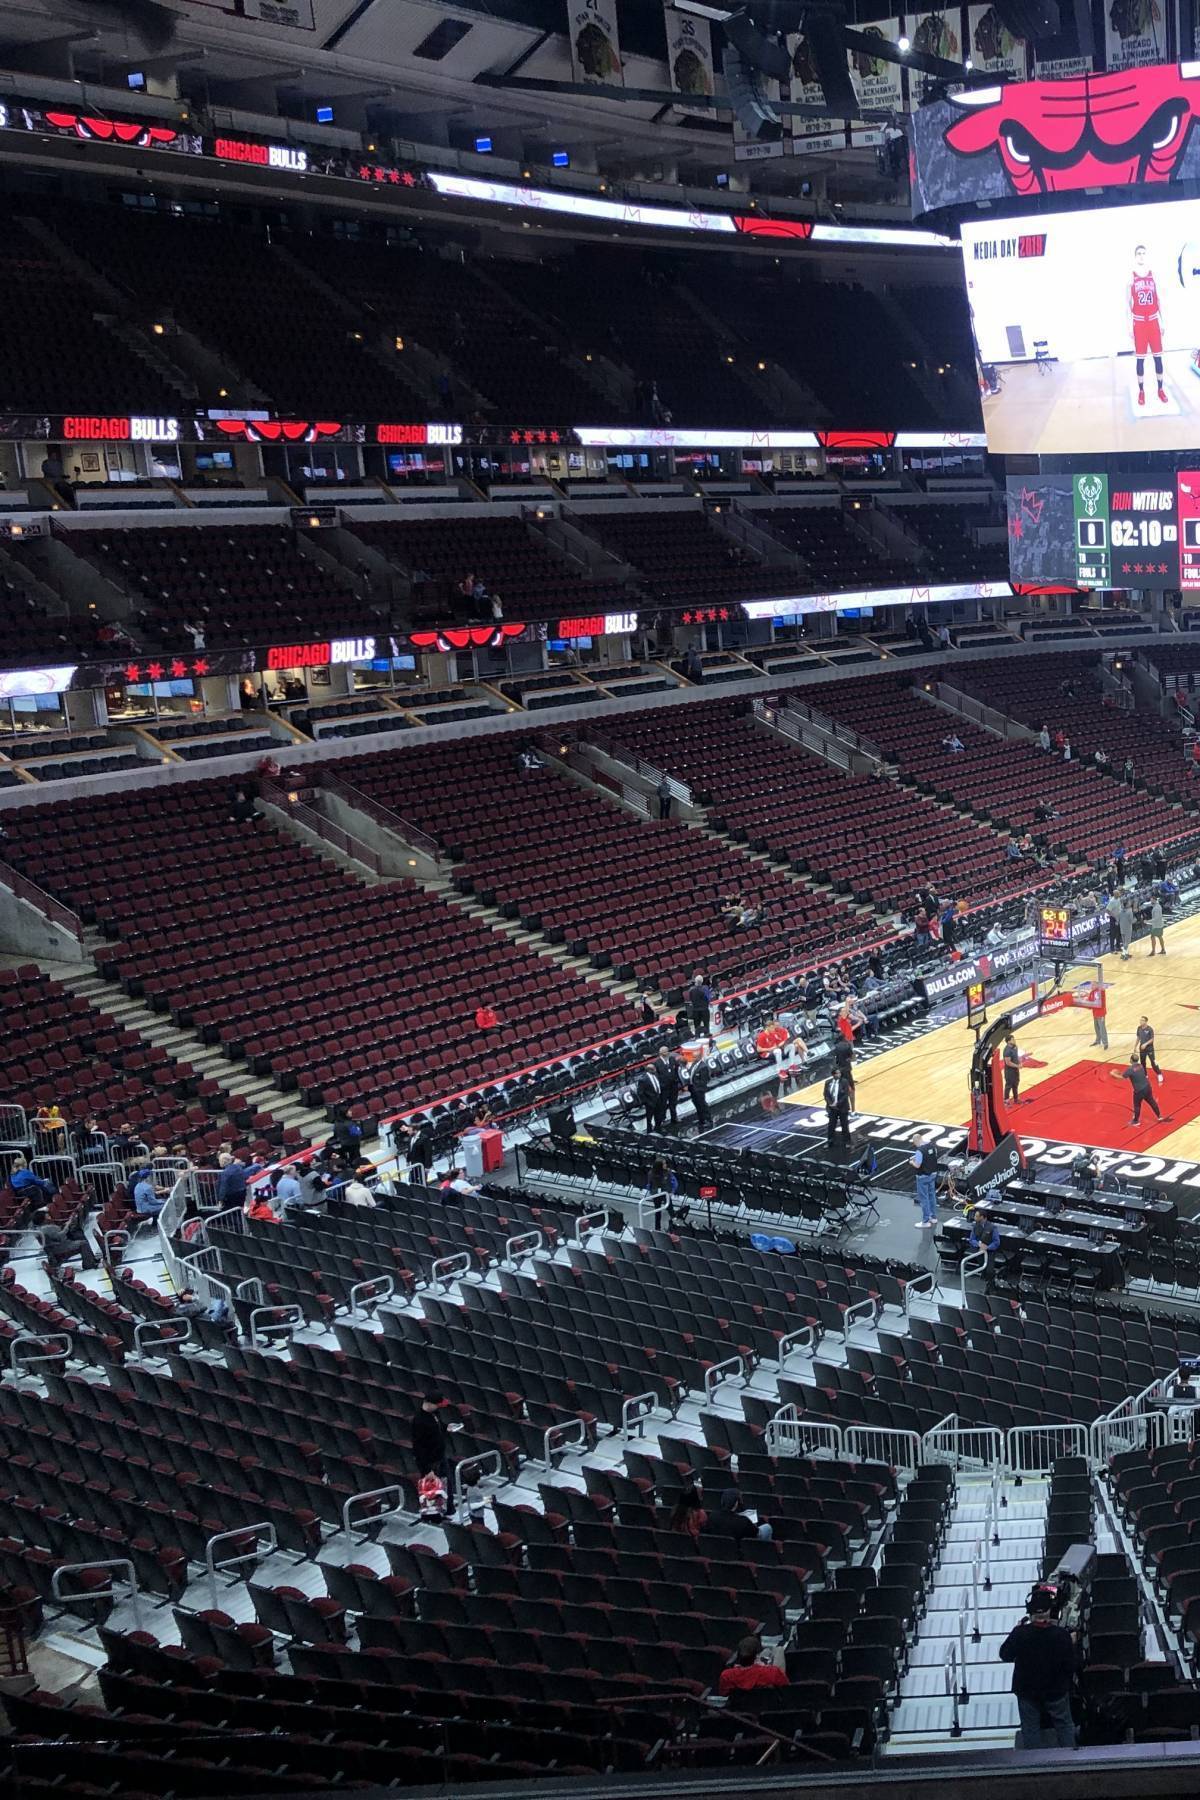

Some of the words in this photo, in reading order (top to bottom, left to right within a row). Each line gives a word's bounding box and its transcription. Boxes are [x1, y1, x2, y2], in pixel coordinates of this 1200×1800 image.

[1121, 38, 1151, 50] CHICAGO
[1112, 48, 1160, 61] BLACKHAWKS
[985, 58, 1013, 71] CHICAGO
[862, 77, 888, 87] CHICAGO
[803, 83, 823, 95] CHICA
[215, 138, 268, 164] CHICAGO
[268, 146, 307, 170] BULLS
[974, 241, 998, 260] MEDIA
[1001, 239, 1016, 258] DAY
[1138, 292, 1154, 306] 24
[63, 417, 129, 440] CHICAGO
[130, 417, 178, 440] BULLS
[377, 424, 426, 444] CHICAGO
[427, 424, 463, 444] BULLS
[1112, 492, 1132, 511] RUN
[1132, 492, 1159, 511] WITH
[1159, 491, 1174, 511] US
[1111, 520, 1161, 546] 62:10
[1079, 567, 1096, 578] FOULS
[558, 617, 604, 640] CHICAGO
[604, 614, 638, 635] BULLS
[267, 642, 330, 670] CHICAGO
[331, 638, 375, 664] BULLS
[1042, 910, 1067, 922] 62:10
[1046, 921, 1066, 937] 24
[926, 966, 977, 996] BULLS.COM
[794, 1023, 802, 1034] G
[805, 1019, 814, 1029] G
[734, 1047, 743, 1059] G
[746, 1043, 755, 1054] G
[708, 1058, 717, 1069] G
[721, 1052, 730, 1063] G
[682, 1068, 690, 1079] G
[623, 1091, 634, 1103] G
[975, 1166, 1017, 1197] TransUnion
